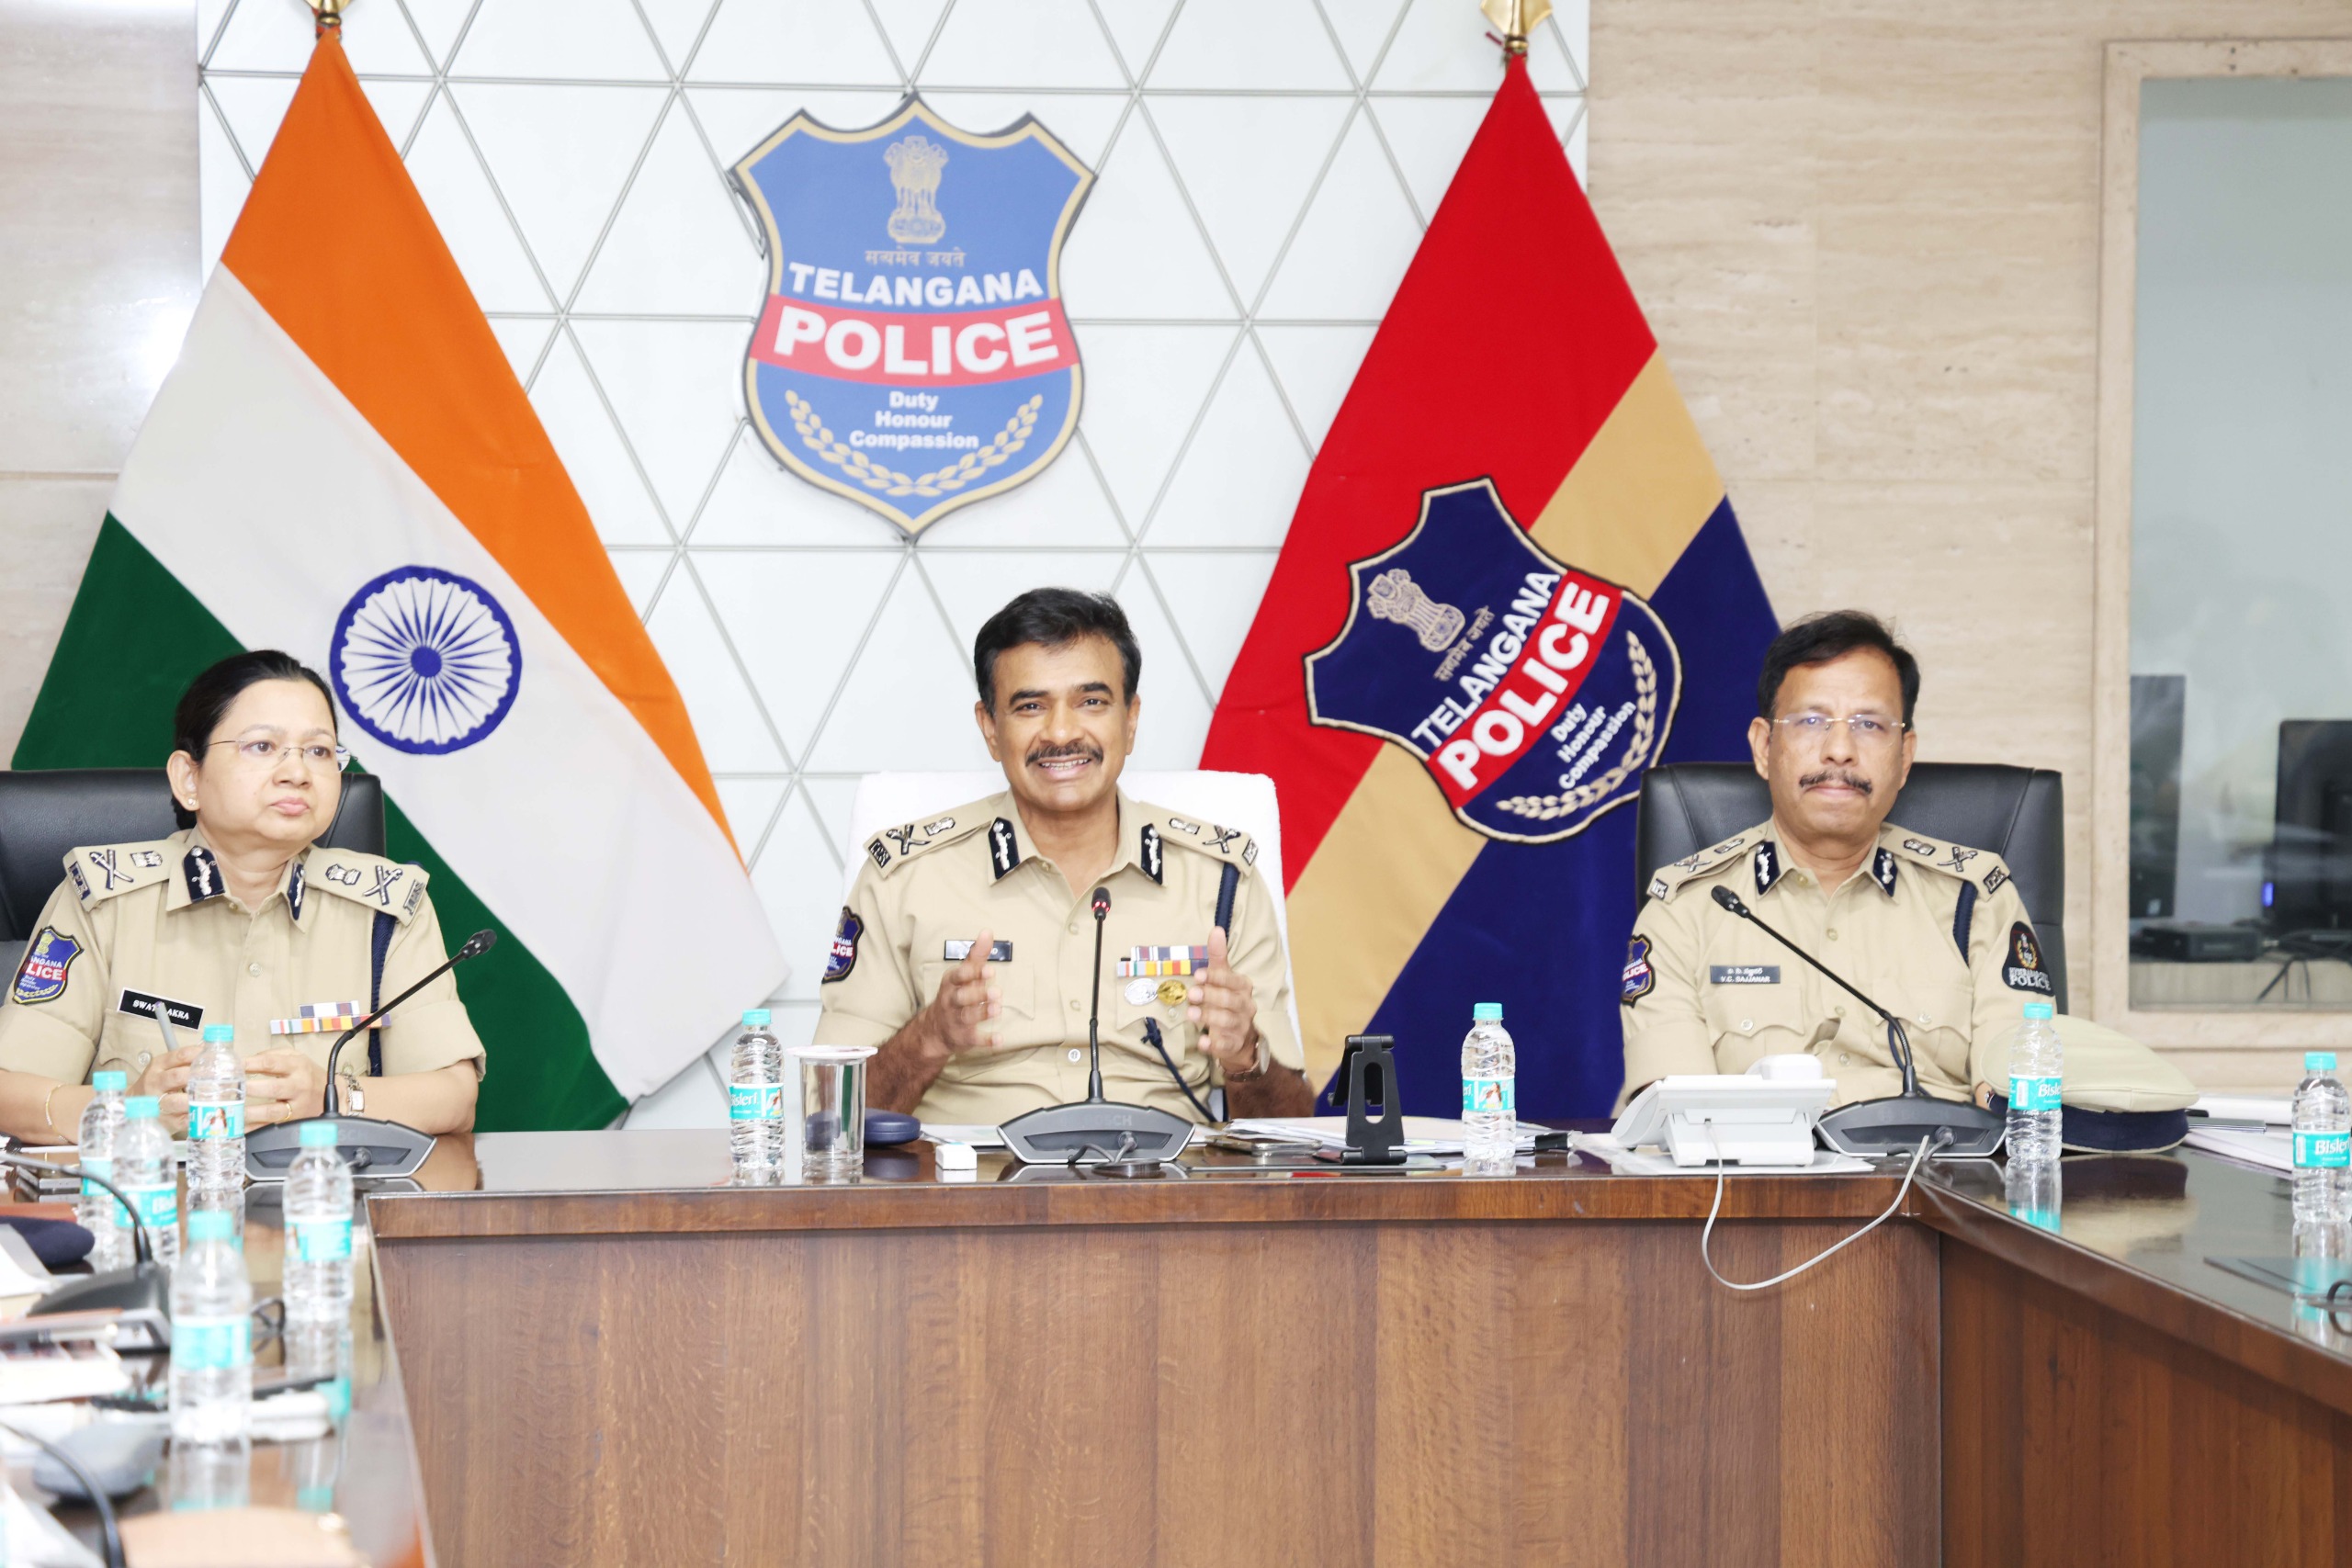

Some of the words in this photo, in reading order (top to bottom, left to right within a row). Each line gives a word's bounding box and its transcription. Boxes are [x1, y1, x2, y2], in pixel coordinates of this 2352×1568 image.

[926, 246, 967, 267] जयते
[788, 262, 1044, 307] TELANGANA
[773, 304, 1060, 376] POLICE
[875, 410, 954, 429] Honour
[888, 390, 939, 412] Duty
[849, 430, 980, 452] Compassion
[1410, 572, 1561, 748] TELANGANA
[1437, 581, 1611, 791] POLICE
[1550, 702, 1588, 743] Duty
[1556, 705, 1607, 763] Honour
[1558, 701, 1636, 790] Compassion
[2009, 974, 2052, 991] POLICE
